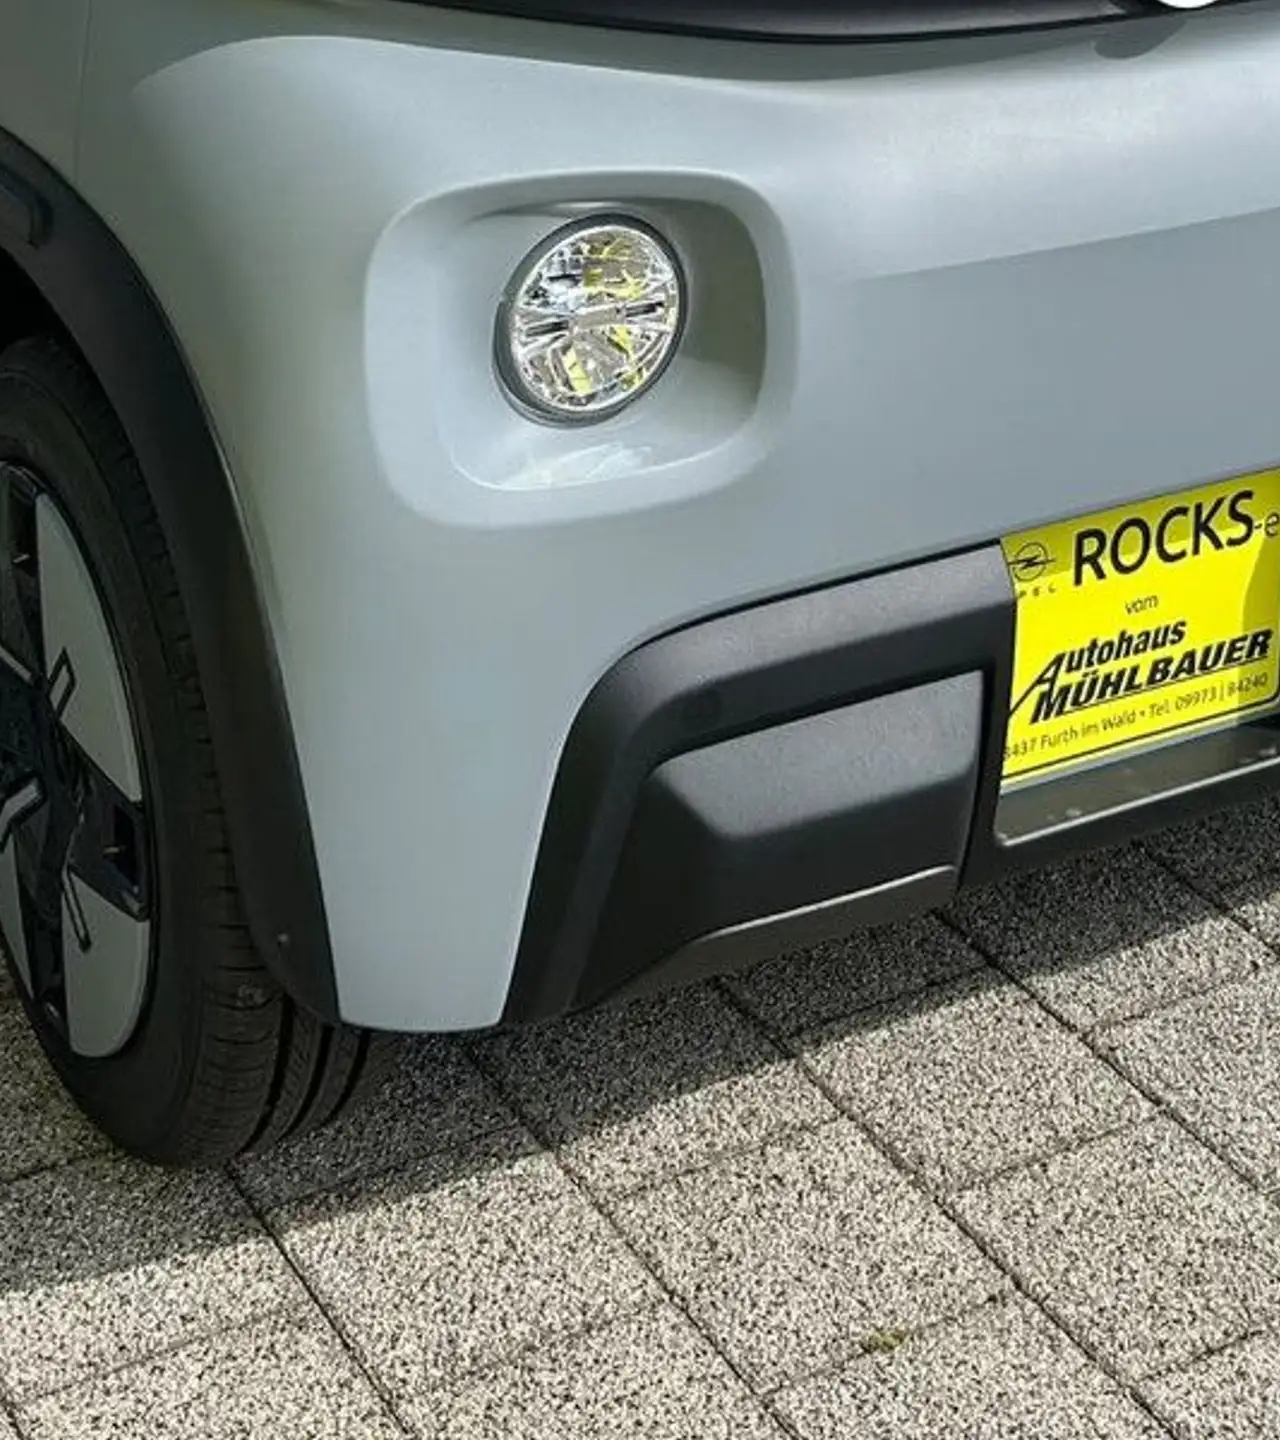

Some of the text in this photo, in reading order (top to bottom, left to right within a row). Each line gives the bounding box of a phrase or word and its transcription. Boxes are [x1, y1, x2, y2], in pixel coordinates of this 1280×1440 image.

[1073, 490, 1280, 587] ROCKS-e
[1125, 594, 1160, 615] vom
[1014, 619, 1188, 708] Autohaus
[1028, 628, 1274, 726] MÜHLBAUER
[1040, 727, 1079, 750] Furth
[1081, 722, 1099, 738] im
[1101, 709, 1137, 732] Wald
